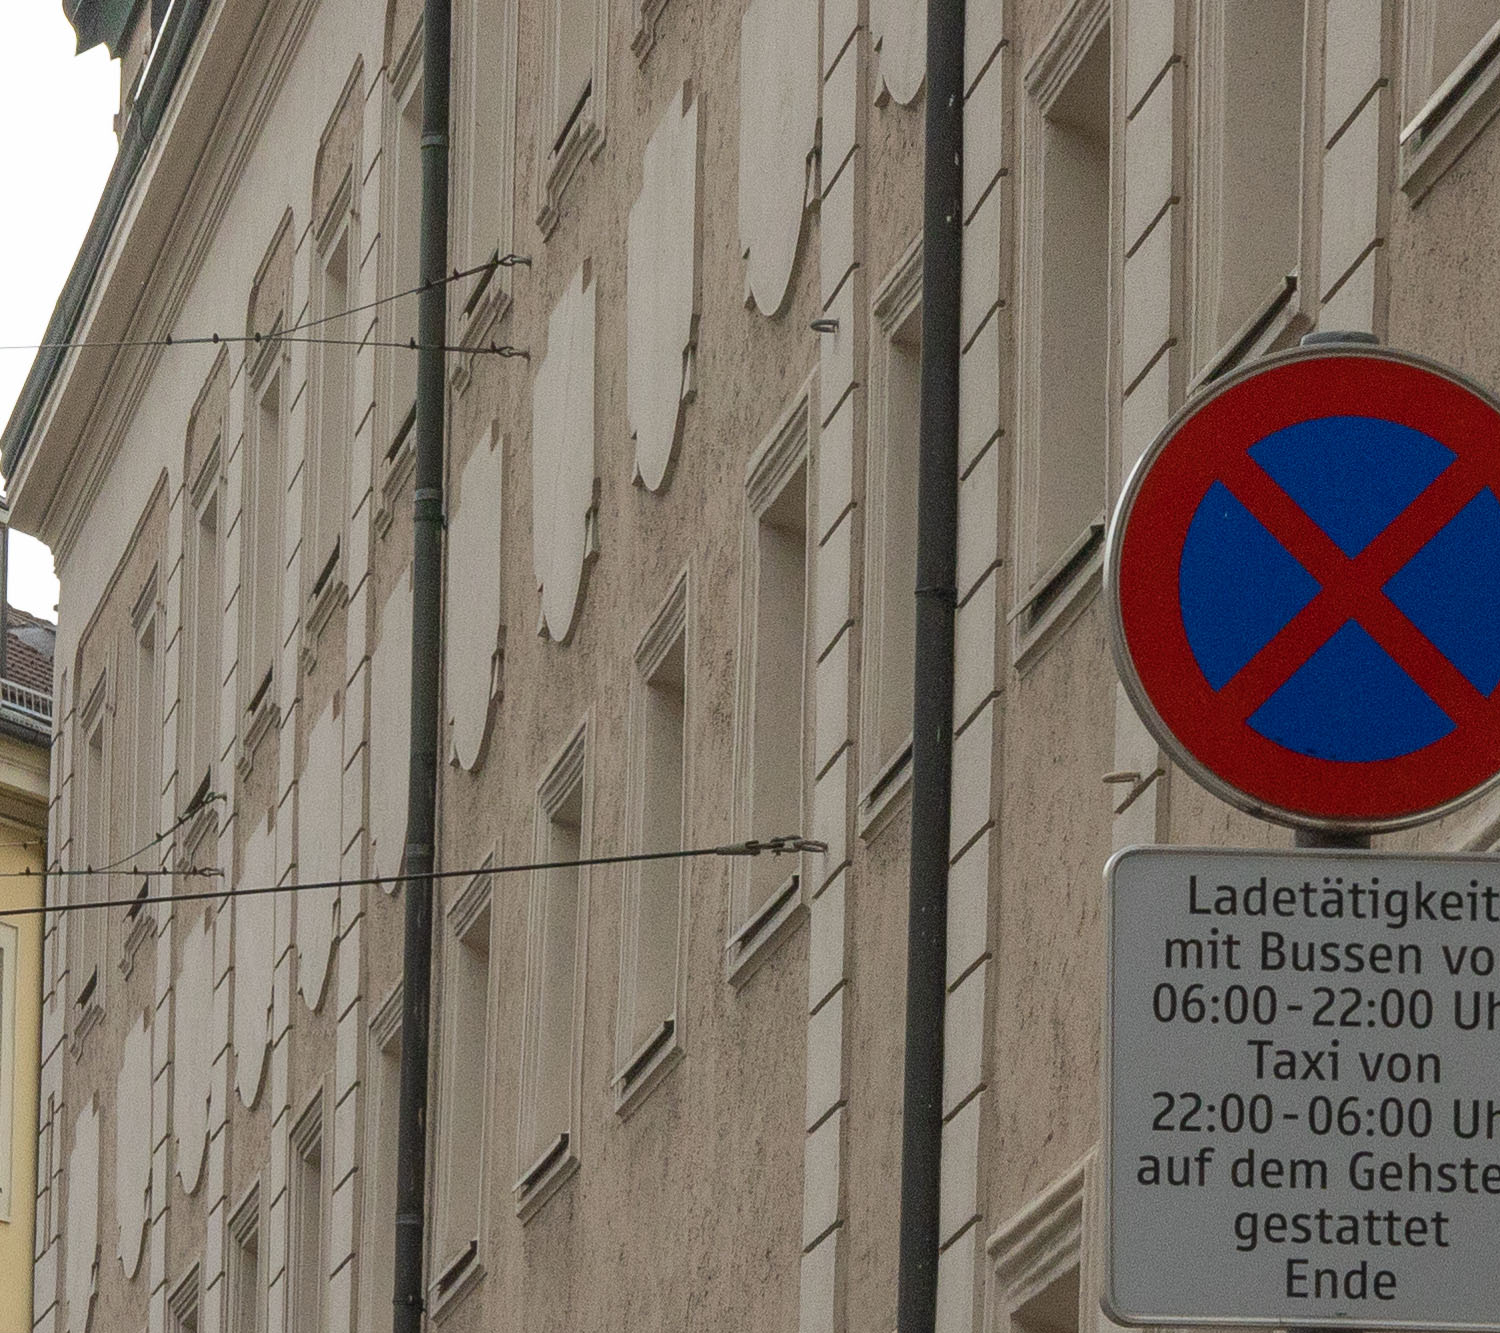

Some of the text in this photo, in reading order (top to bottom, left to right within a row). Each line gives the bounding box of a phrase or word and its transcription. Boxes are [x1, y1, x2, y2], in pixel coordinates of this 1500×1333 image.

[1188, 875, 1500, 929] Ladetätigkeit
[1165, 930, 1241, 970] mit
[1260, 932, 1423, 974] Bussen
[1248, 1040, 1442, 1083] Taxi von
[1137, 1148, 1214, 1186] auf
[1231, 1150, 1328, 1190] dem
[1235, 1211, 1449, 1252] gestattet
[1286, 1259, 1397, 1300] Ende
